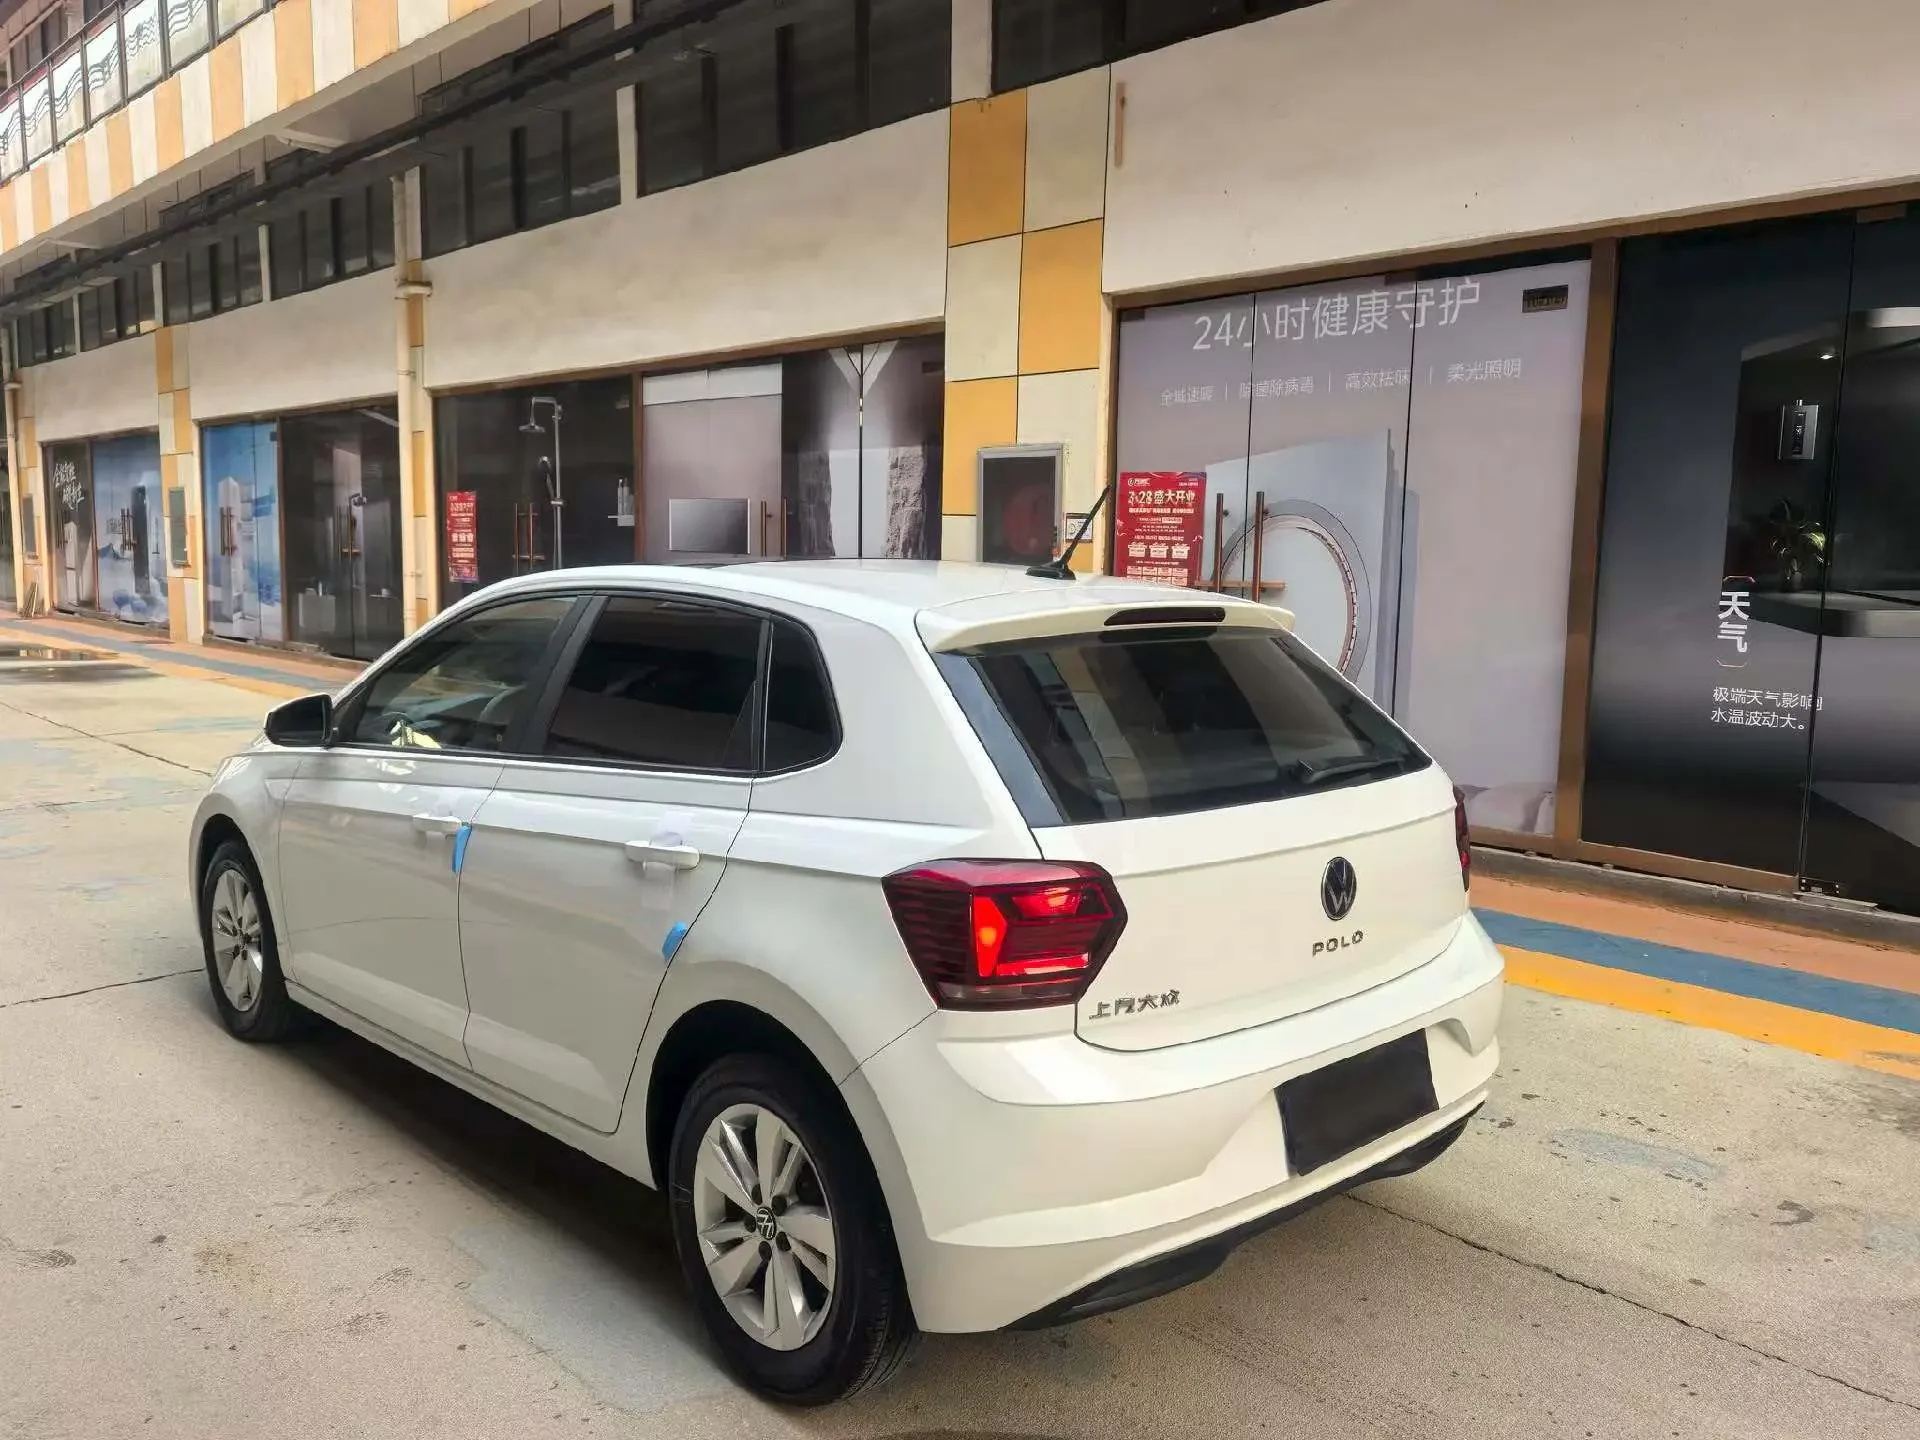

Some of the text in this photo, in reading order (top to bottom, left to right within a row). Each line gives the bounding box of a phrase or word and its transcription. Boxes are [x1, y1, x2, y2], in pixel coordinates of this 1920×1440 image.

[1192, 276, 1481, 351] 24小时健康守护
[1448, 357, 1522, 383] 柔光照明
[1717, 591, 1750, 653] 天气
[1712, 685, 1823, 711] 极端天气影响
[1311, 929, 1364, 957] POLO
